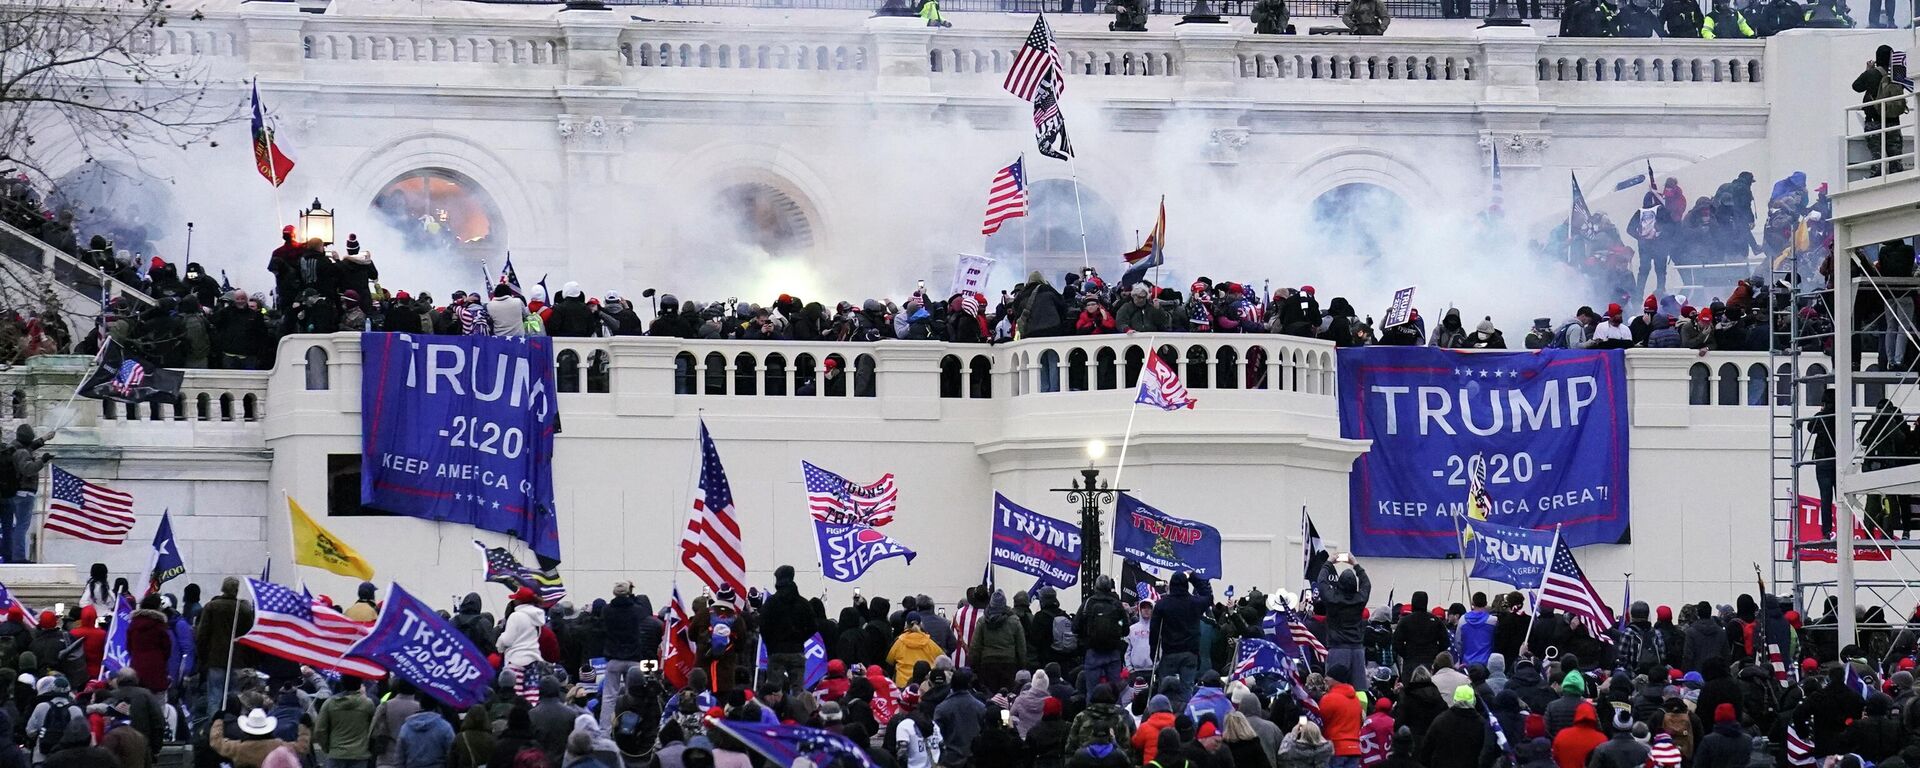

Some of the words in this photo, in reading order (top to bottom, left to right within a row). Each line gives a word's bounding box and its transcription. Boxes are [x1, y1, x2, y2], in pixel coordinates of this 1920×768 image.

[1397, 289, 1412, 322] TRUMP
[1371, 375, 1598, 436] TRUMP
[381, 453, 430, 475] KEEP
[1378, 500, 1428, 517] KEEP
[1436, 500, 1530, 517] AMICA
[1538, 486, 1609, 512] GREAT!
[826, 526, 850, 535] FIGHT
[1000, 503, 1082, 553] TRUMP
[995, 547, 1010, 559] NO
[1010, 551, 1039, 568] MORE
[1125, 547, 1145, 558] KEEP
[399, 609, 481, 684] TRUMP
